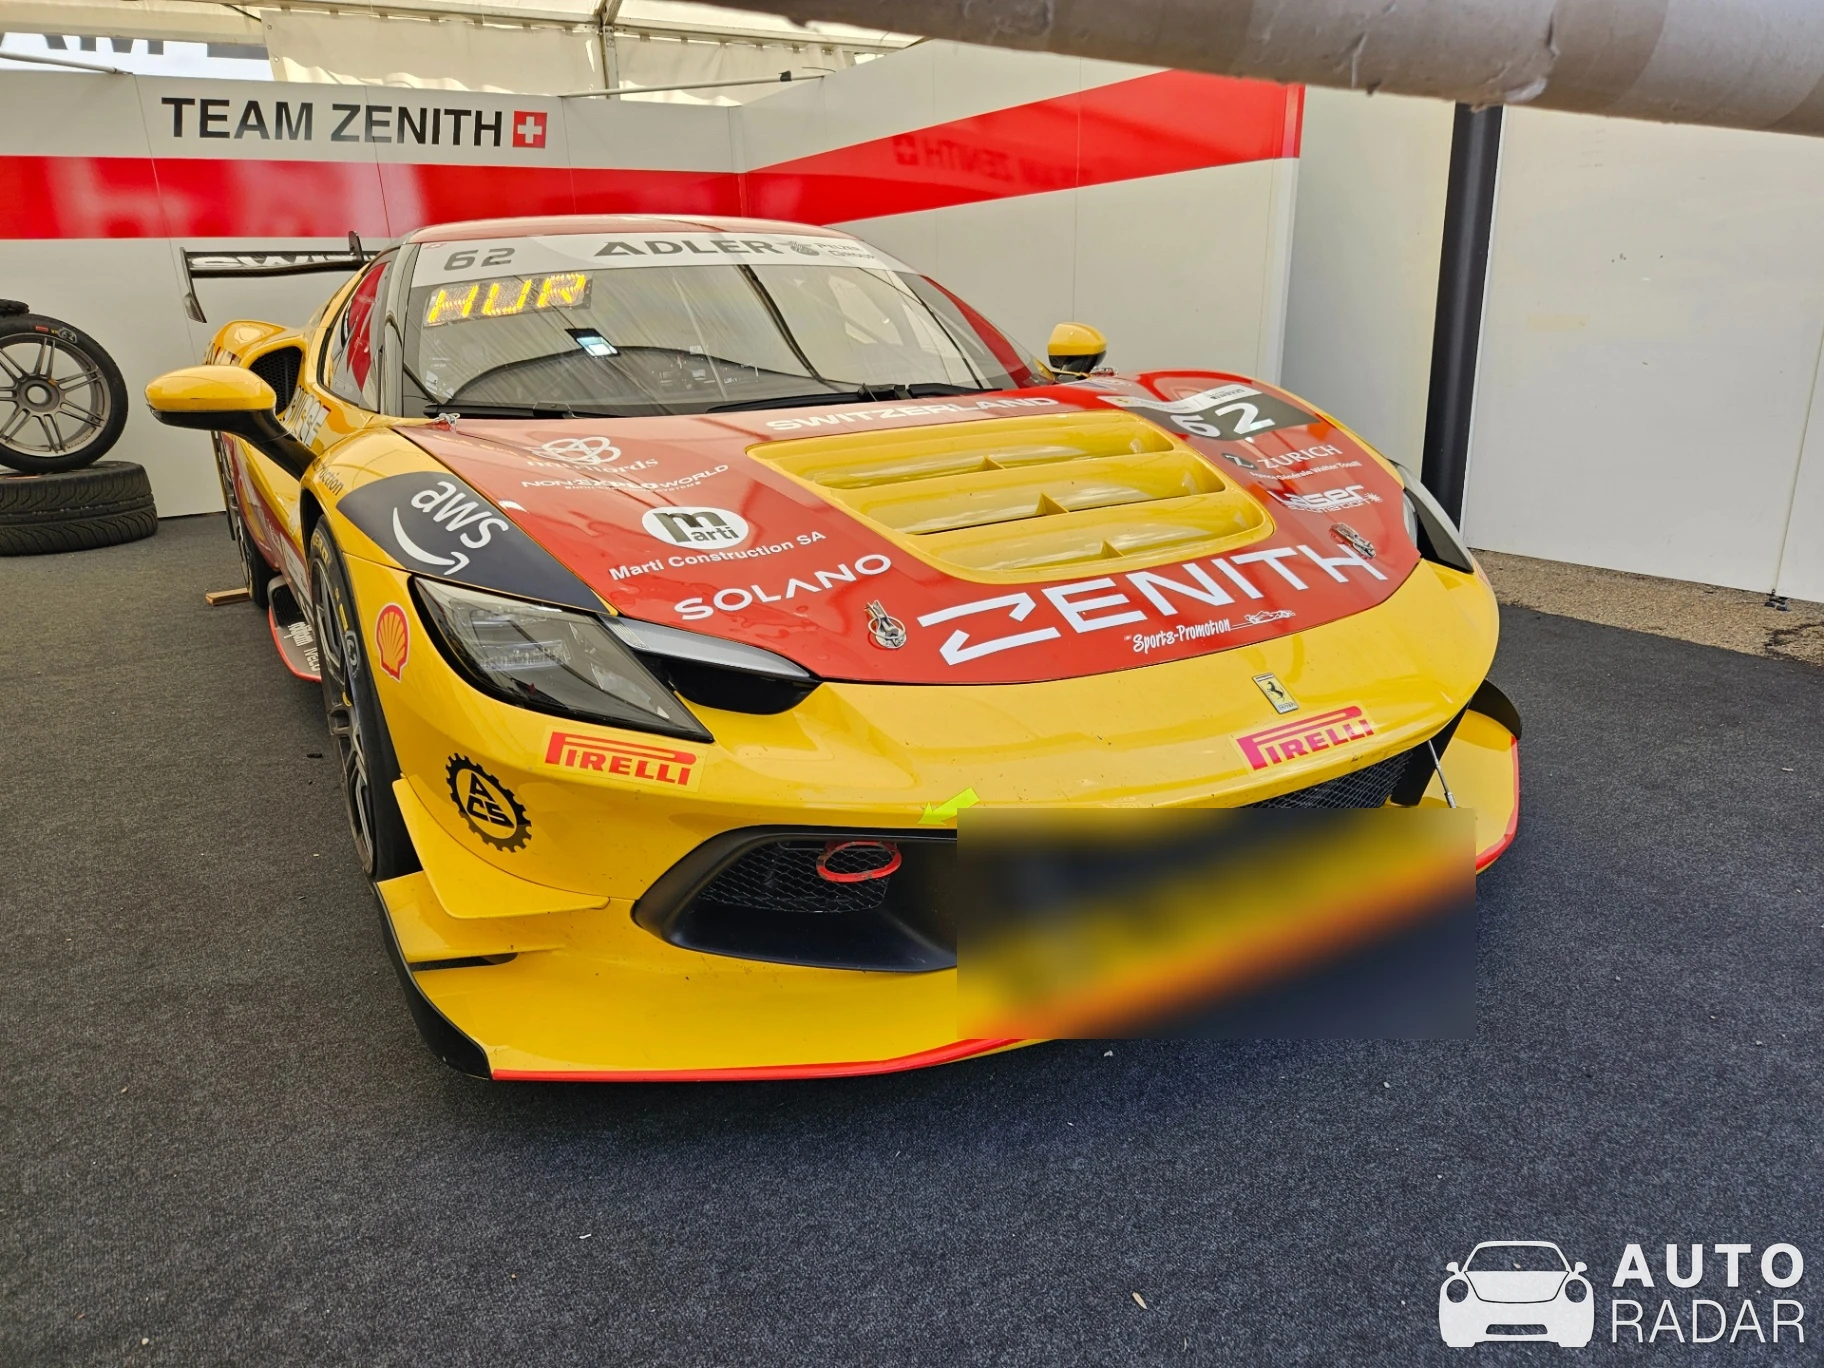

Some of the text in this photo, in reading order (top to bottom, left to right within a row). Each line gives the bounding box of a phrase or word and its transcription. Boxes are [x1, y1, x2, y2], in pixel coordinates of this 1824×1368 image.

[161, 96, 503, 147] TEAM ZENITH
[443, 247, 516, 271] 62
[593, 240, 785, 257] ADLER
[427, 272, 587, 325] HUR
[765, 396, 1060, 431] SWITZERLAND
[1169, 402, 1276, 438] 62
[1256, 444, 1344, 469] ZURICH
[411, 481, 511, 549] aws
[609, 530, 827, 581] Marti Construction SA
[674, 554, 892, 621] SOLANO
[917, 543, 1389, 666] ZENITH
[1132, 618, 1231, 655] Sports-Promotion
[544, 731, 698, 787] PIRELLI
[1236, 705, 1375, 771] PIRELLI
